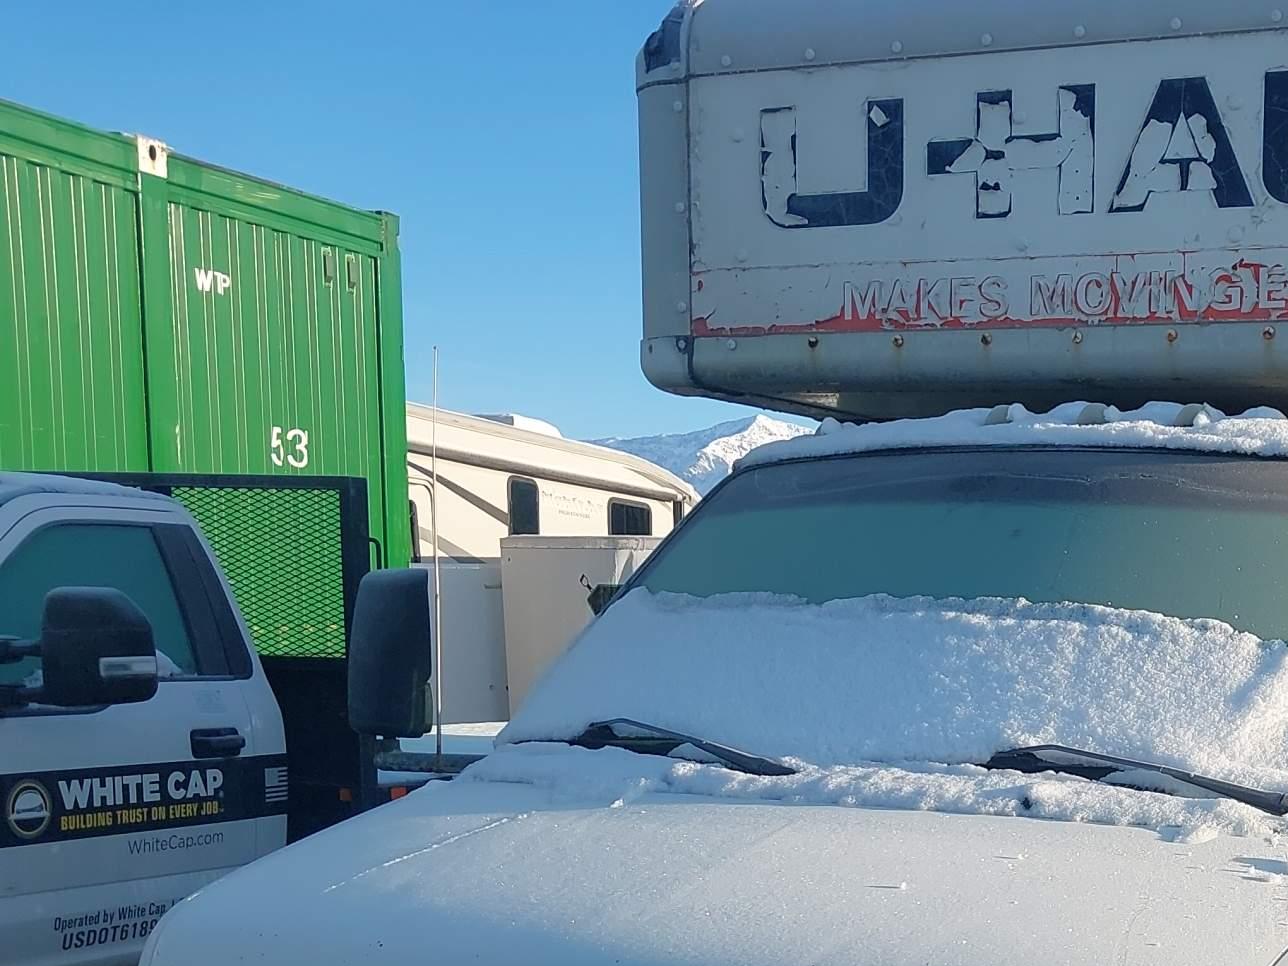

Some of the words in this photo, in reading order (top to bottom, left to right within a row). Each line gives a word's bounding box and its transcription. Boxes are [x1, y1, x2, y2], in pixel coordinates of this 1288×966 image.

[844, 275, 1008, 322] MAKES
[1030, 266, 1250, 317] MOVING
[271, 426, 308, 468] 53
[58, 773, 161, 810] WHITE
[167, 769, 223, 800] CAP
[60, 811, 113, 831] BUILDING
[116, 808, 148, 825] TRUST
[151, 806, 166, 821] ON
[169, 803, 199, 819] EVERY
[201, 801, 219, 816] JOB
[128, 831, 224, 855] WhiteCap.com
[54, 912, 100, 933] Operated
[103, 909, 115, 925] by
[118, 904, 146, 921] White
